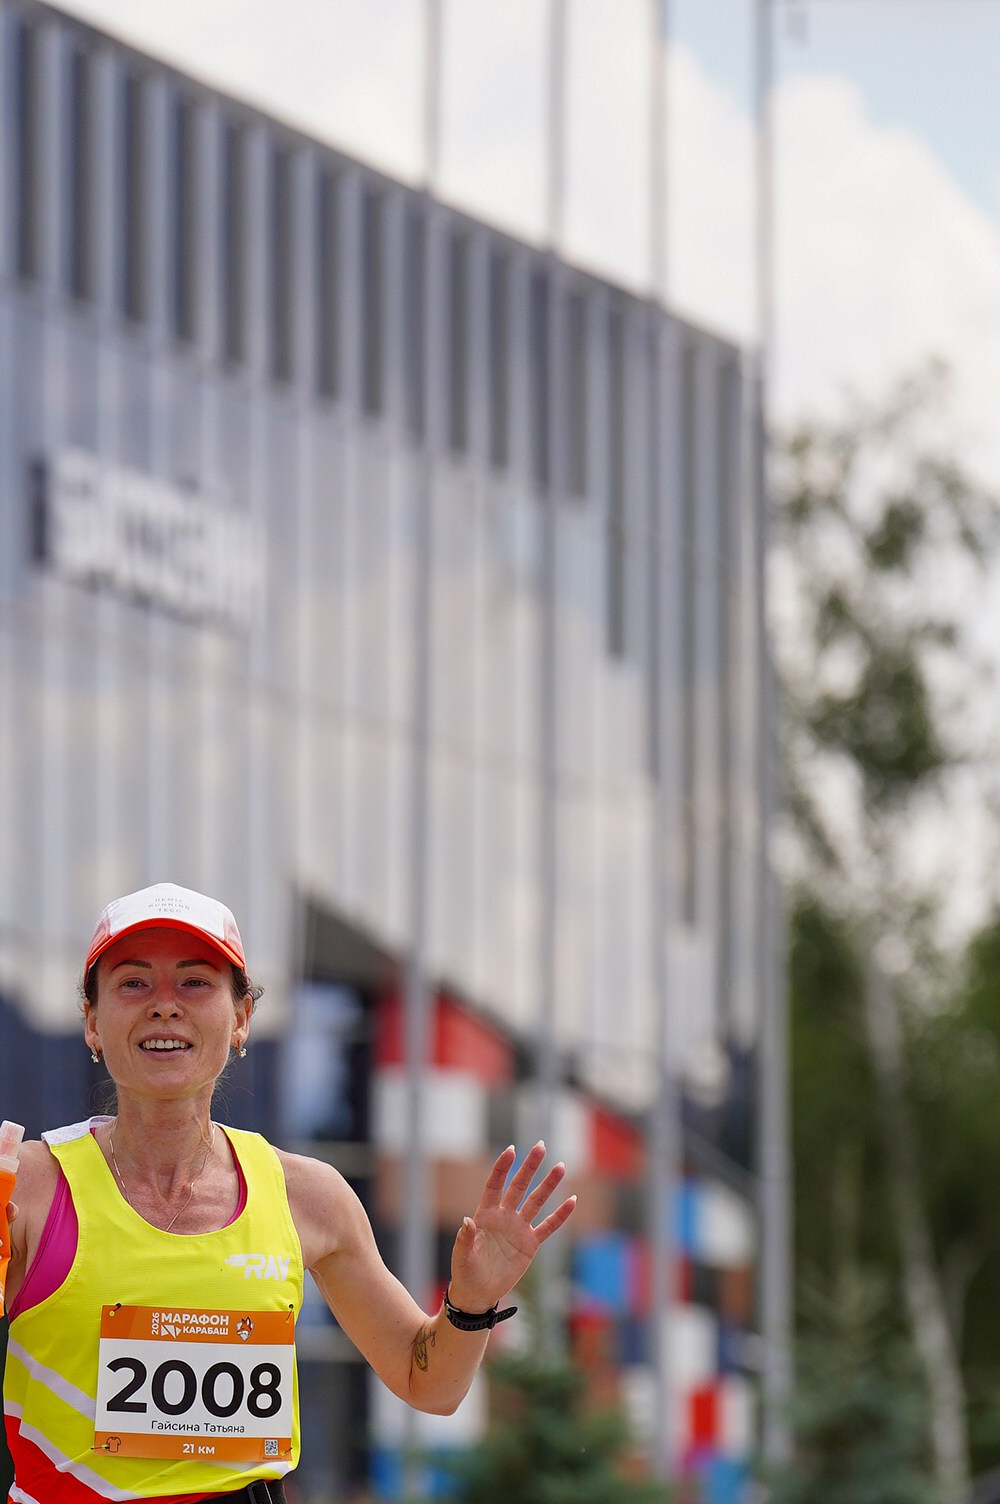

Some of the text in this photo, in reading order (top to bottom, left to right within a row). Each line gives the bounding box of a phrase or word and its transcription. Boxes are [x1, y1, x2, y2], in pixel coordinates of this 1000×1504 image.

[151, 1312, 159, 1335] 2026
[161, 1312, 229, 1326] МАРАФОН
[182, 1325, 229, 1335] КАРАБАШ
[106, 1357, 282, 1419] 2008
[151, 1420, 245, 1433] Гайсина Татьяна
[182, 1443, 215, 1455] 21 км
